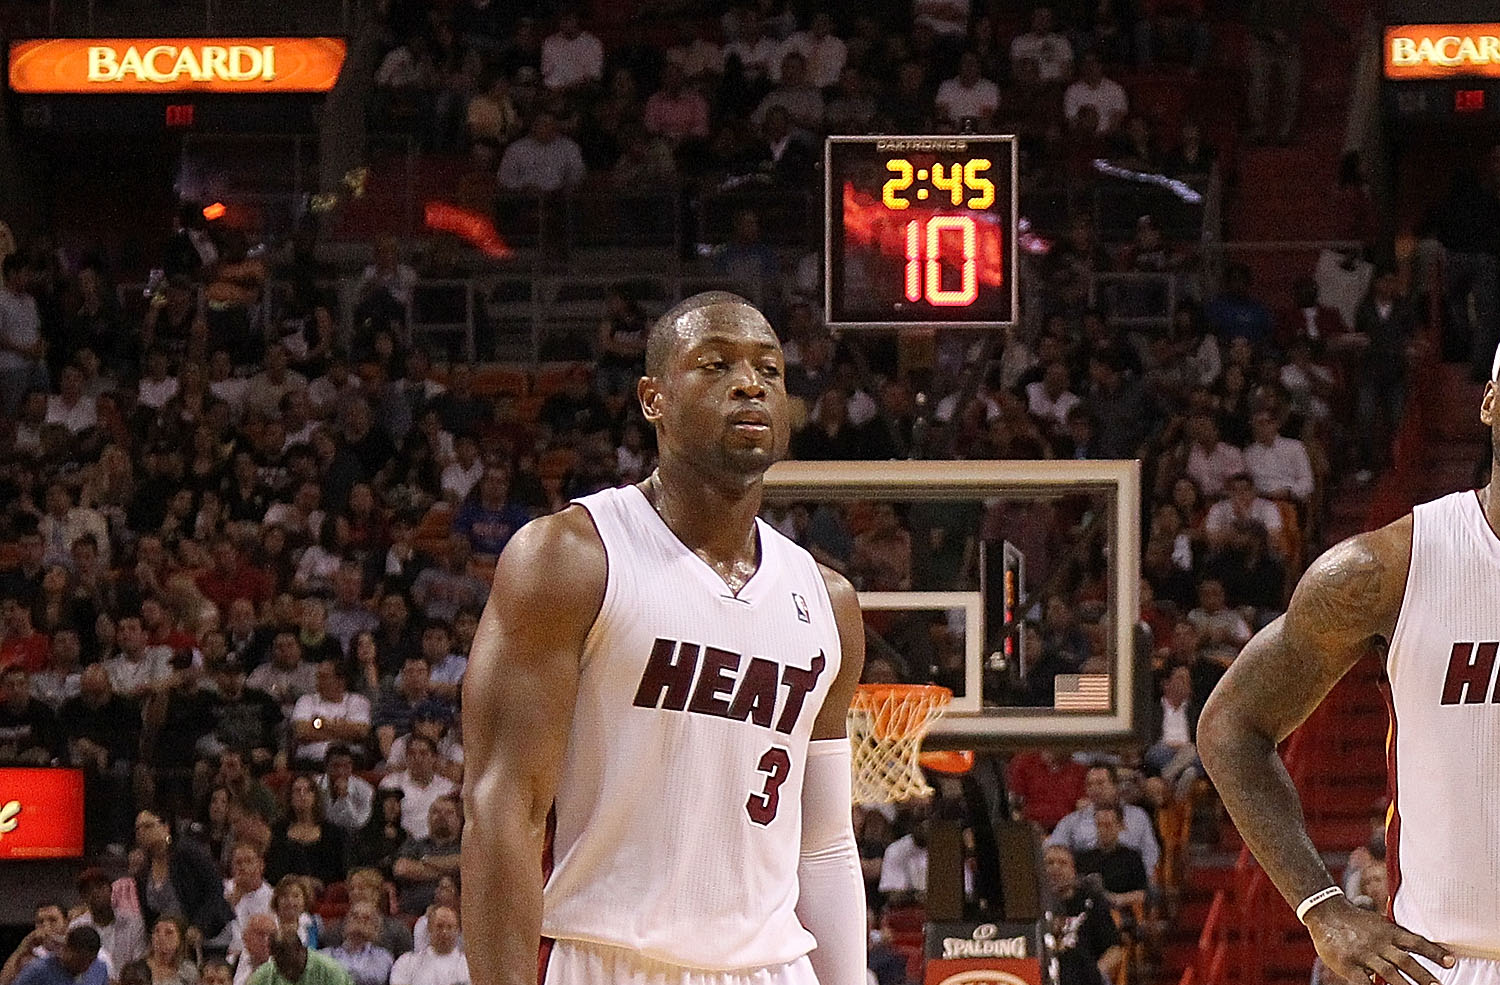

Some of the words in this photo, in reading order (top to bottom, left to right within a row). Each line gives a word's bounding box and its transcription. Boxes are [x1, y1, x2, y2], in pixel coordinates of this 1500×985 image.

[87, 45, 276, 83] BACARDI
[882, 158, 996, 210] 2:45
[905, 215, 978, 307] 10
[632, 638, 826, 735] HEAT
[745, 745, 792, 829] 3
[942, 936, 1027, 960] SPALDING
